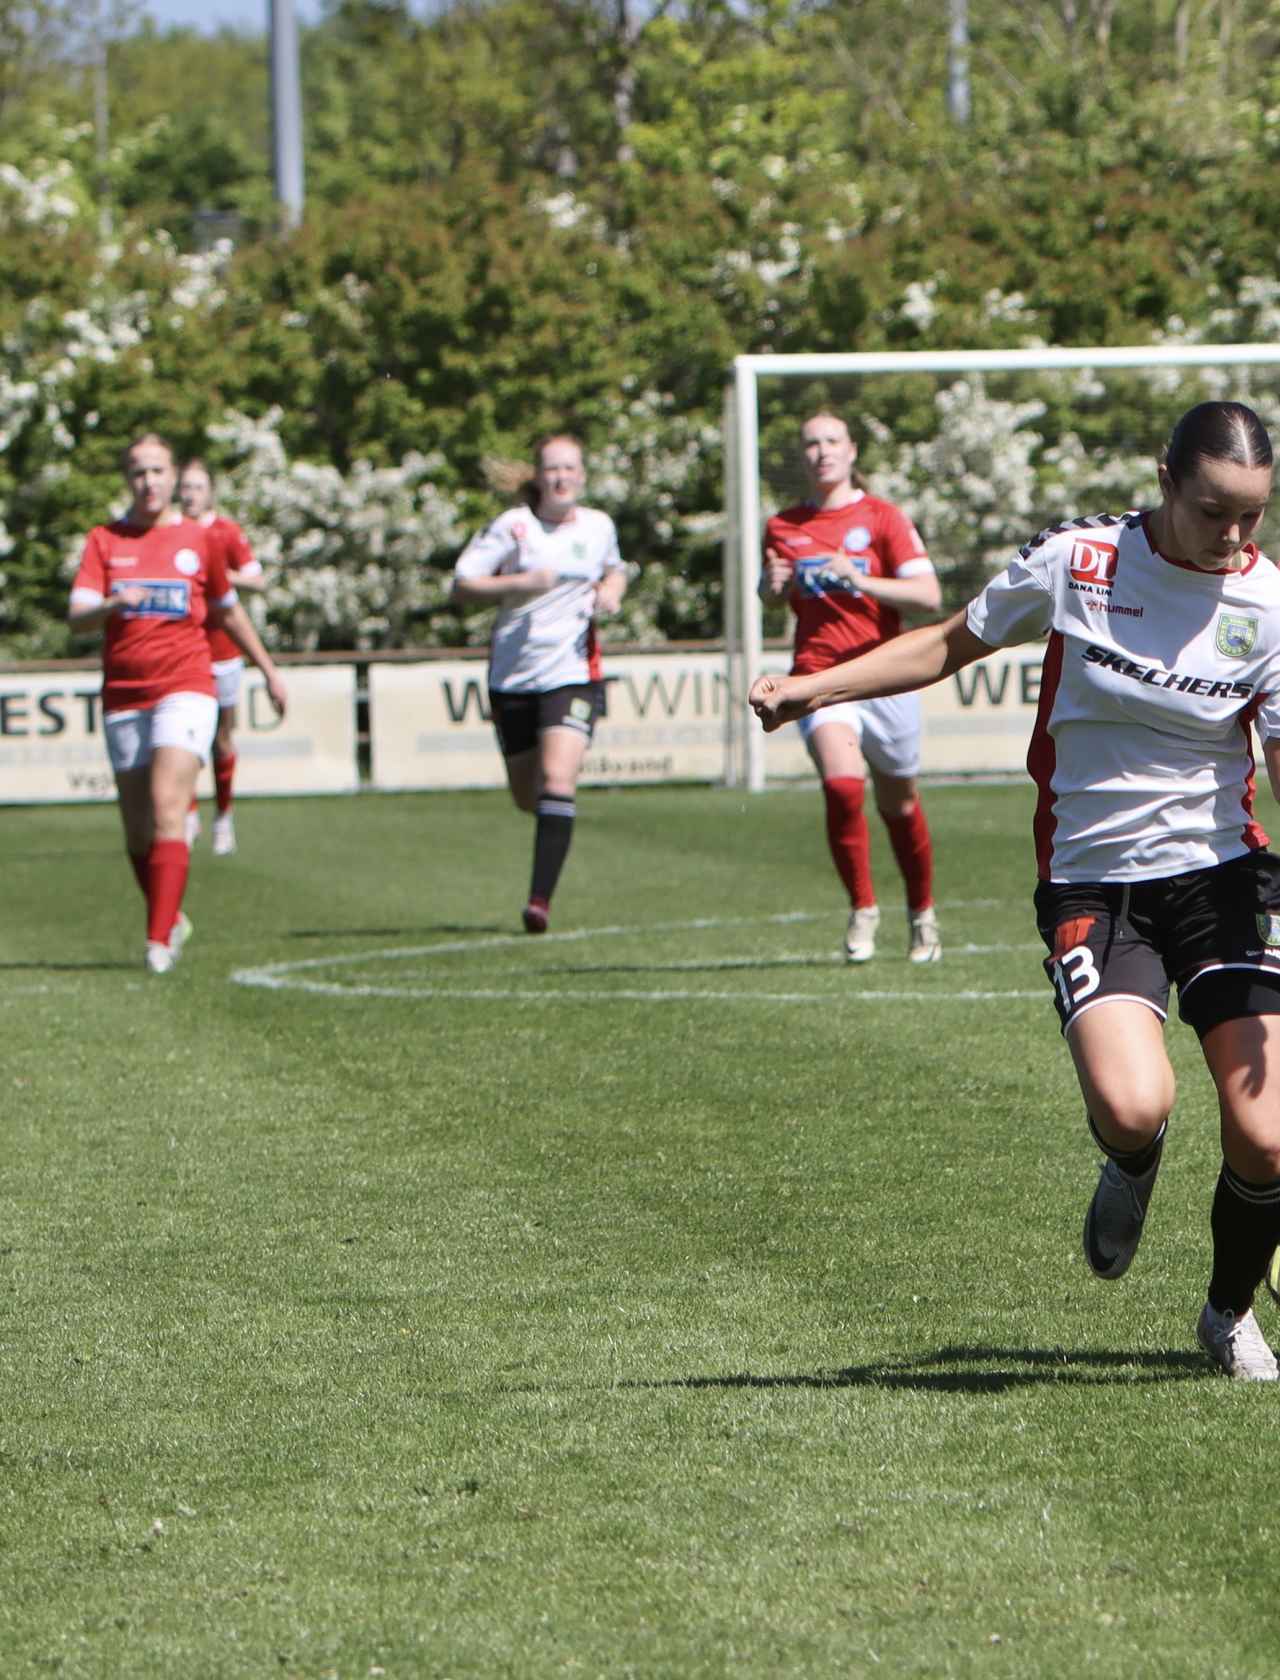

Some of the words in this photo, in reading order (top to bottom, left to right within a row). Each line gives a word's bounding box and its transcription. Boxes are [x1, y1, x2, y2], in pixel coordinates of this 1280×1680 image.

[1068, 582, 1093, 593] DANA
[1096, 588, 1113, 597] LIM
[1100, 601, 1144, 618] hummel
[1081, 645, 1254, 699] SKECHERS
[1054, 945, 1100, 1014] 13
